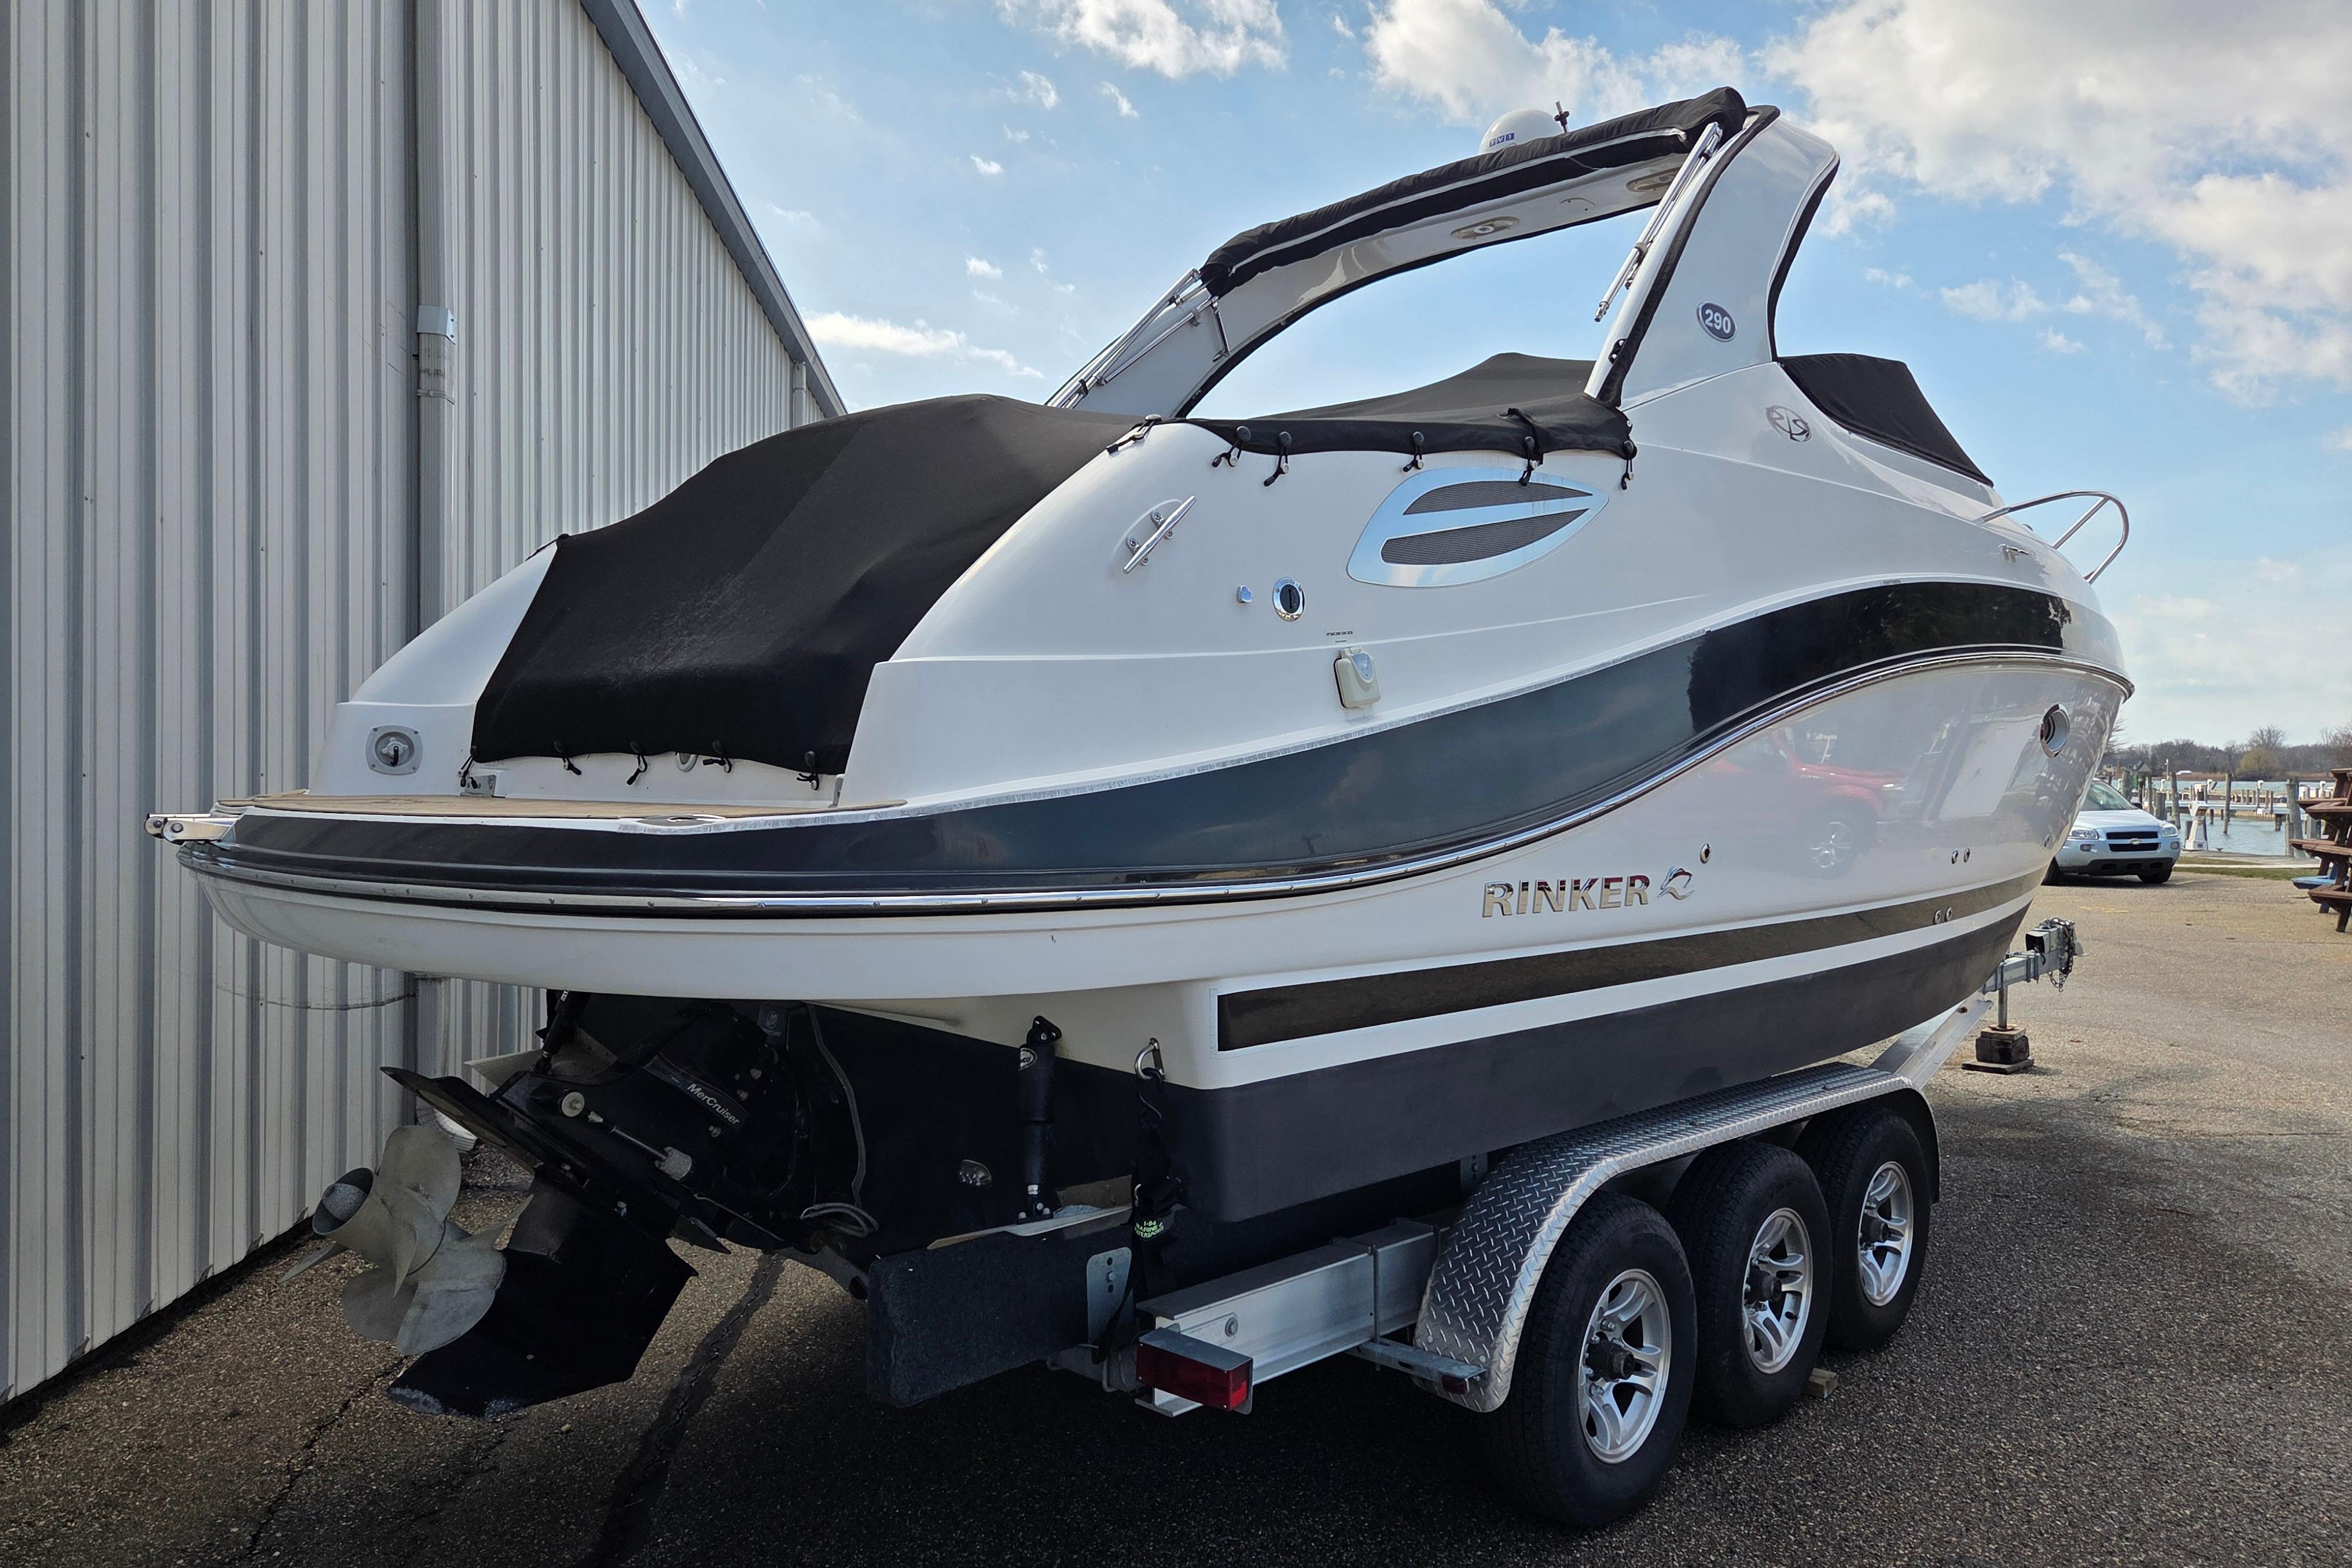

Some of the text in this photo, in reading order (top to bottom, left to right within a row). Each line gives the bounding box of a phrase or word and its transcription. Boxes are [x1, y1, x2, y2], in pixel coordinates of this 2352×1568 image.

[1489, 133, 1513, 146] TV1
[1705, 309, 1731, 334] 290
[1482, 874, 1651, 918] RINKER
[686, 1082, 741, 1125] MerCruiser
[1135, 1222, 1158, 1232] MARINE
